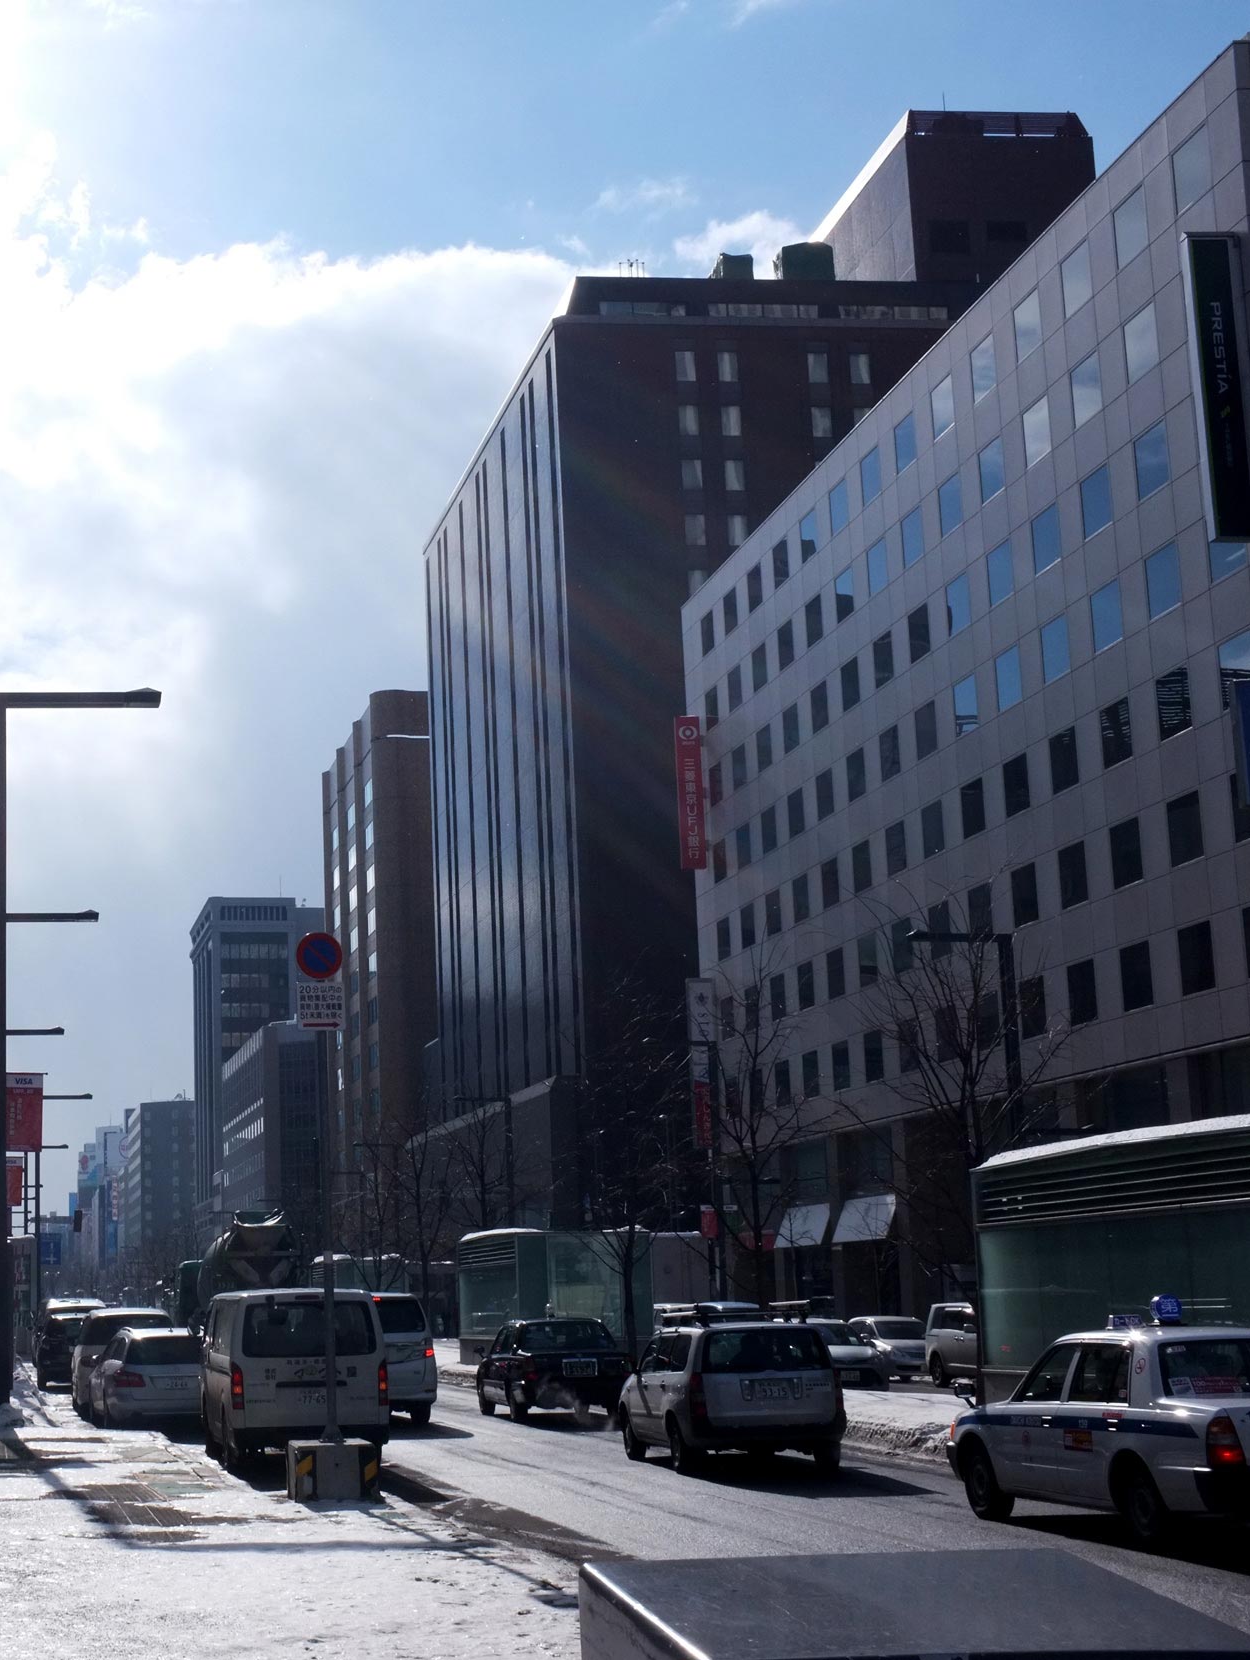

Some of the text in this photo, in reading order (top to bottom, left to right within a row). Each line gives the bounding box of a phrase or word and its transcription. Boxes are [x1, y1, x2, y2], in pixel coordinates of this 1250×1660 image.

[1208, 301, 1230, 394] PRESTIA
[684, 758, 700, 859] 三菱東京UFJ銀行
[13, 1078, 33, 1086] VISA
